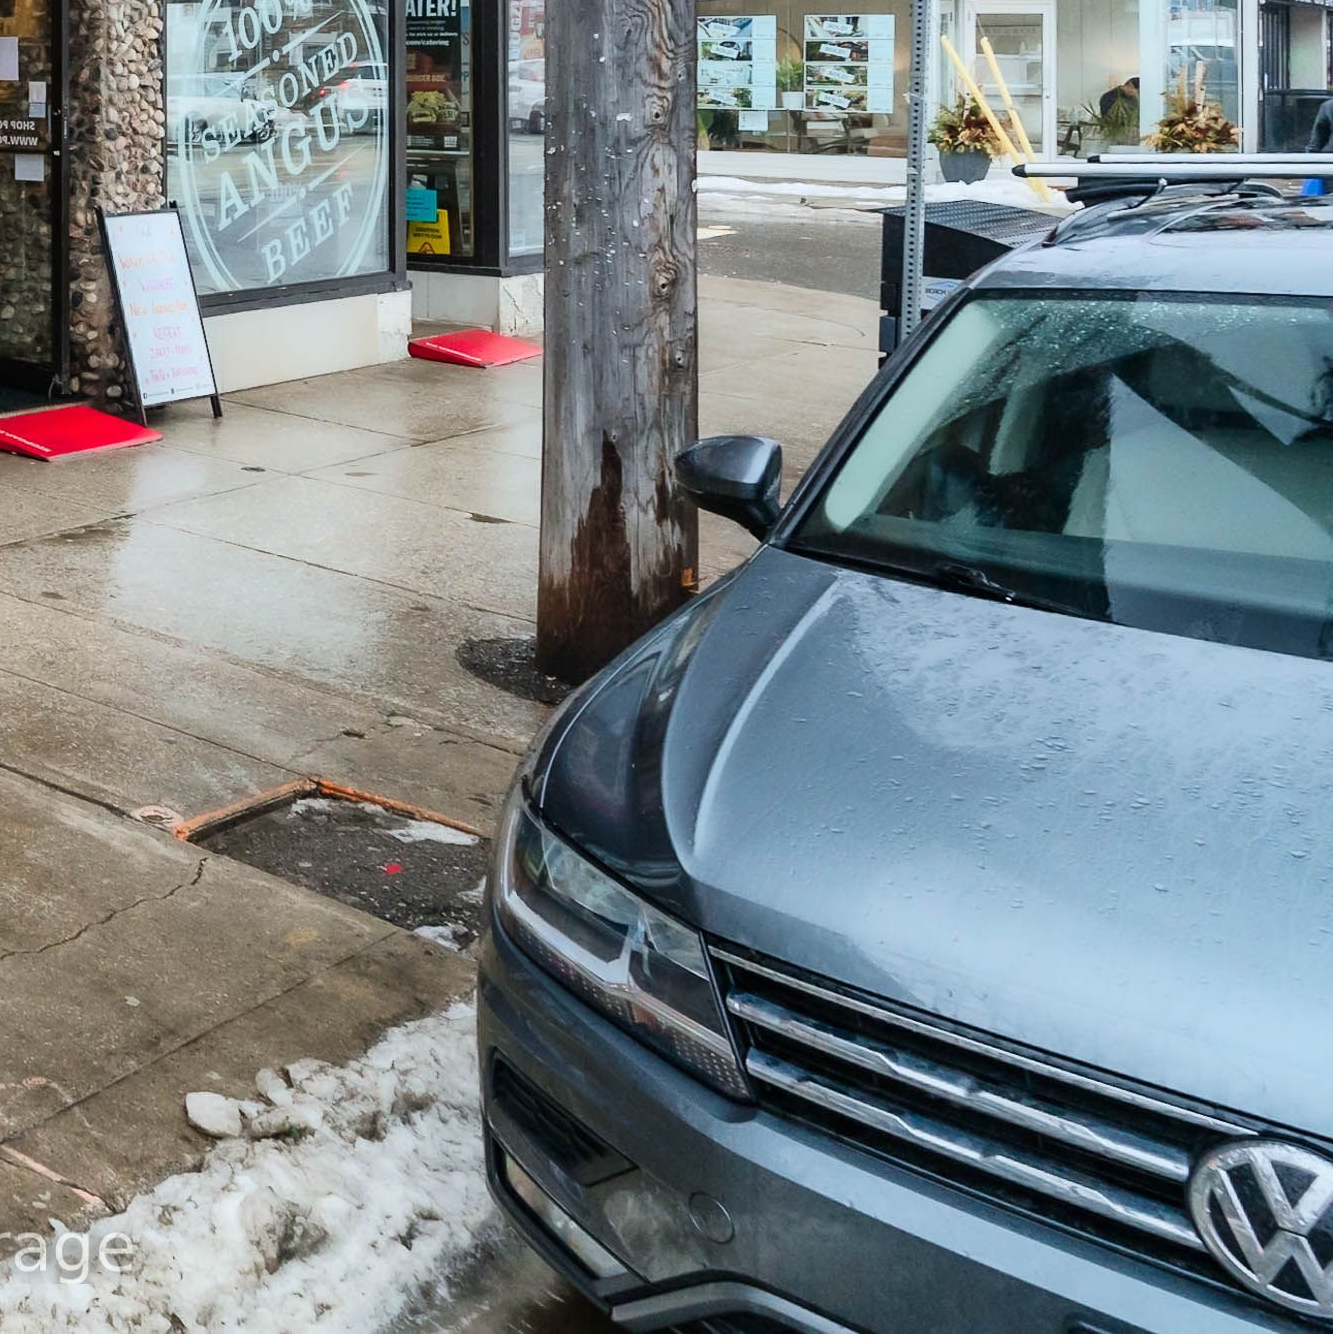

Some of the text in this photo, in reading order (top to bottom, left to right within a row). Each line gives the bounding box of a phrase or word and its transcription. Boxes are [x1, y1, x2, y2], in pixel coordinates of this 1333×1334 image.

[200, 32, 358, 164] SEASONED
[218, 75, 372, 233] ANGUS
[261, 182, 355, 285] BEEF
